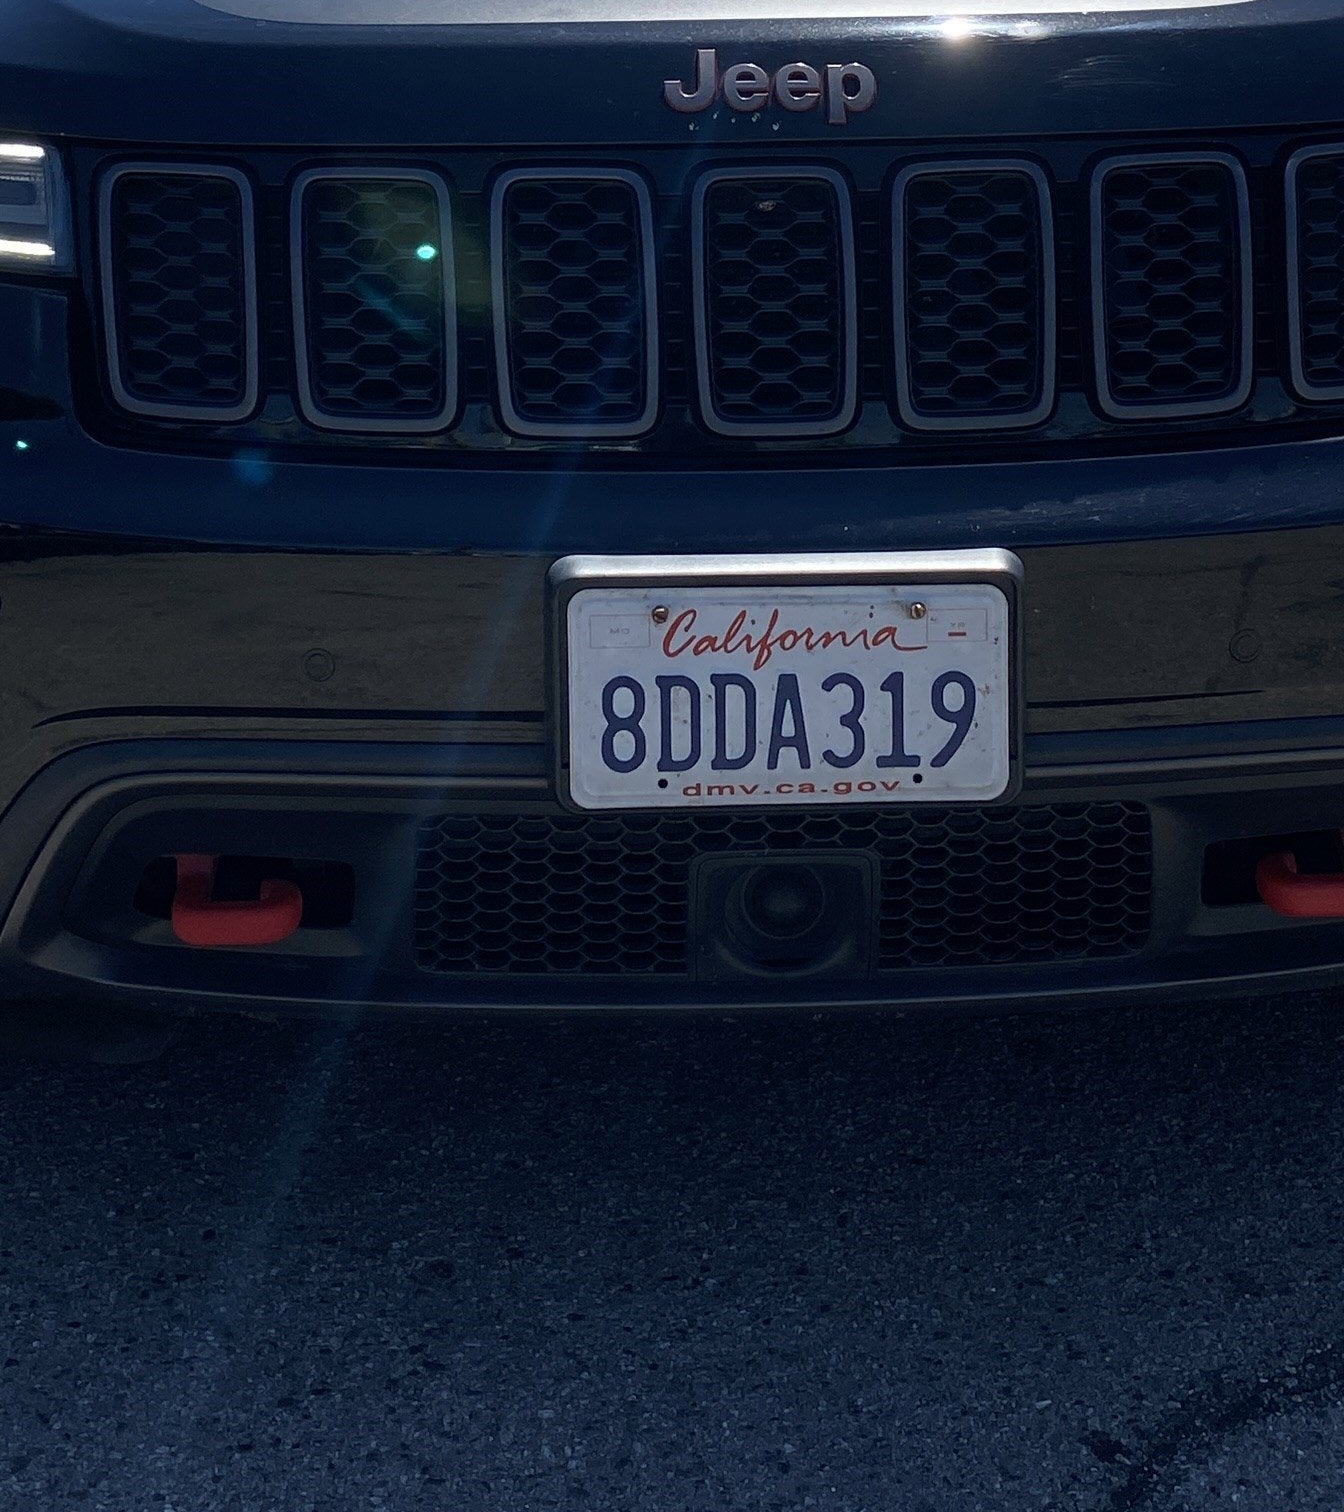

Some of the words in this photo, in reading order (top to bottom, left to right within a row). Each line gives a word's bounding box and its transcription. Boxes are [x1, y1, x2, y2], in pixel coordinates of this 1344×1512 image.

[663, 48, 877, 125] Jeep
[662, 608, 928, 671] California
[601, 670, 977, 773] 8DDA319
[682, 780, 901, 798] dmv.ca.gov
